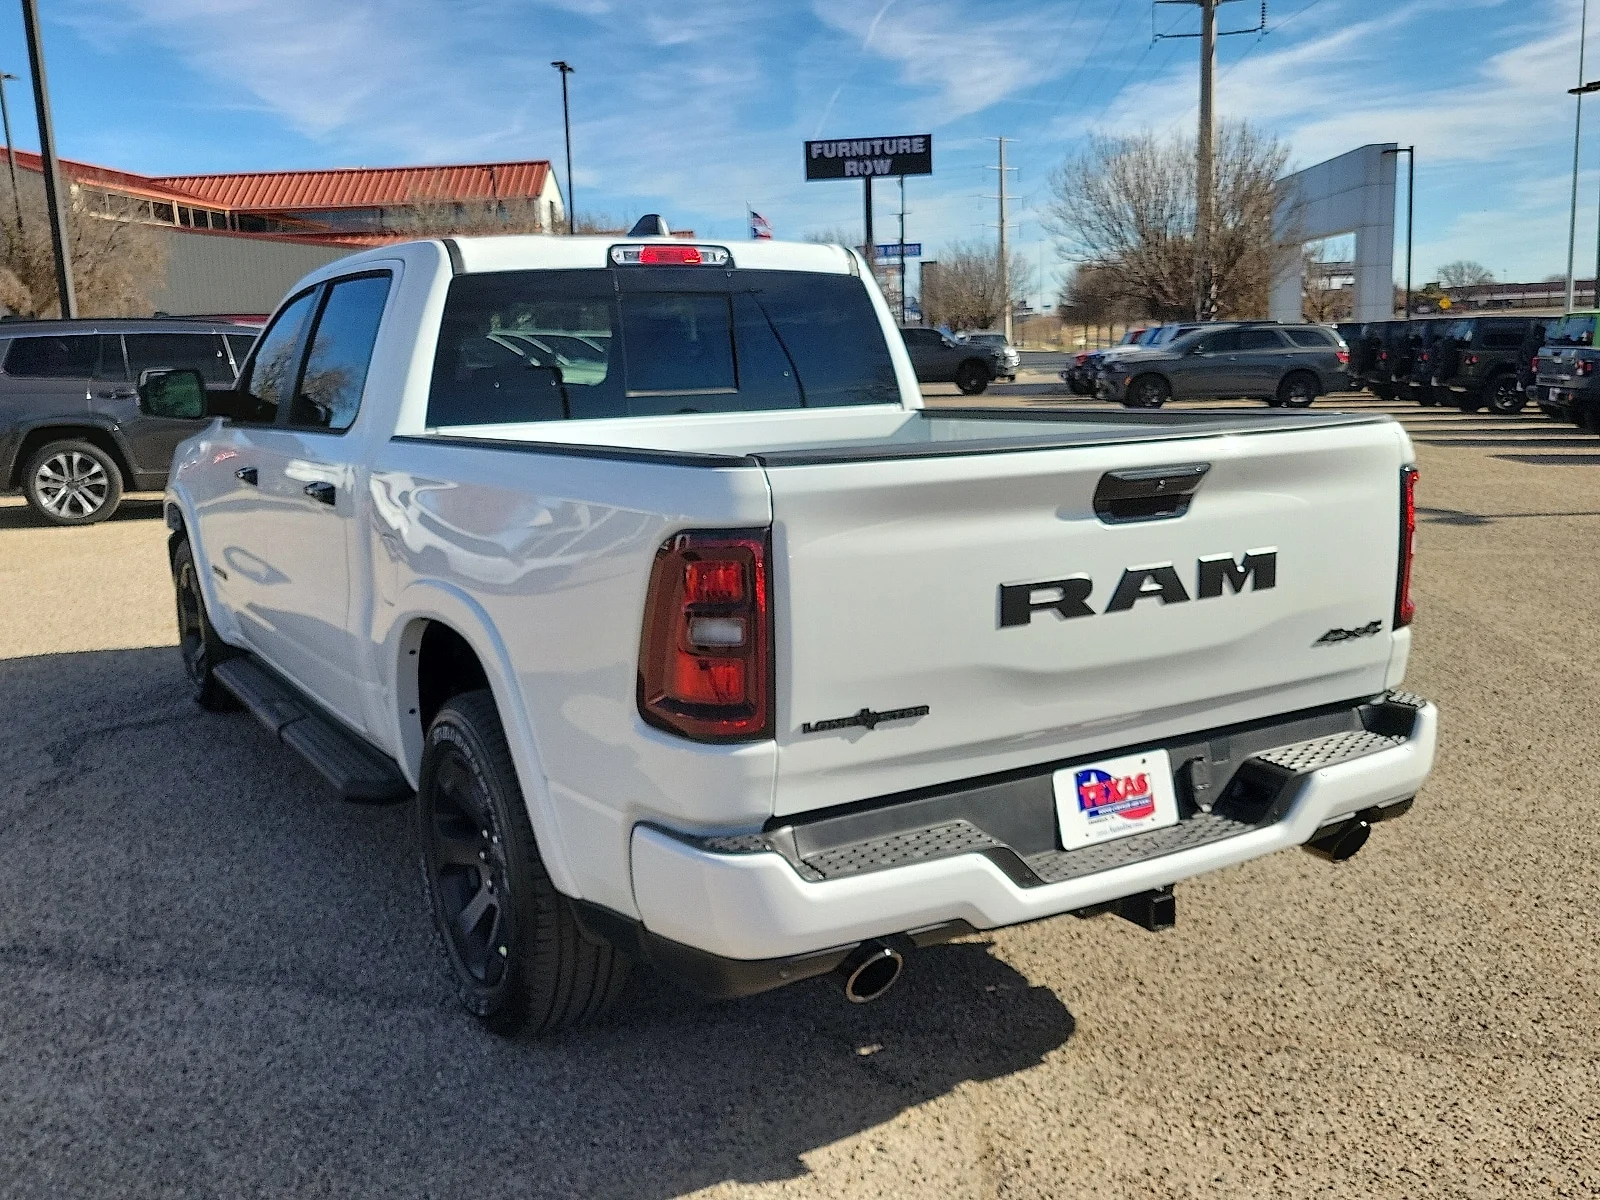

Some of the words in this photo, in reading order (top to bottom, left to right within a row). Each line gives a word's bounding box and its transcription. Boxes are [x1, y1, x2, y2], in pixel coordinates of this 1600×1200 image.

[810, 136, 926, 159] FURNITURE
[843, 158, 893, 177] ROW
[997, 545, 1278, 630] RAM
[1080, 772, 1149, 810] TEXAS
